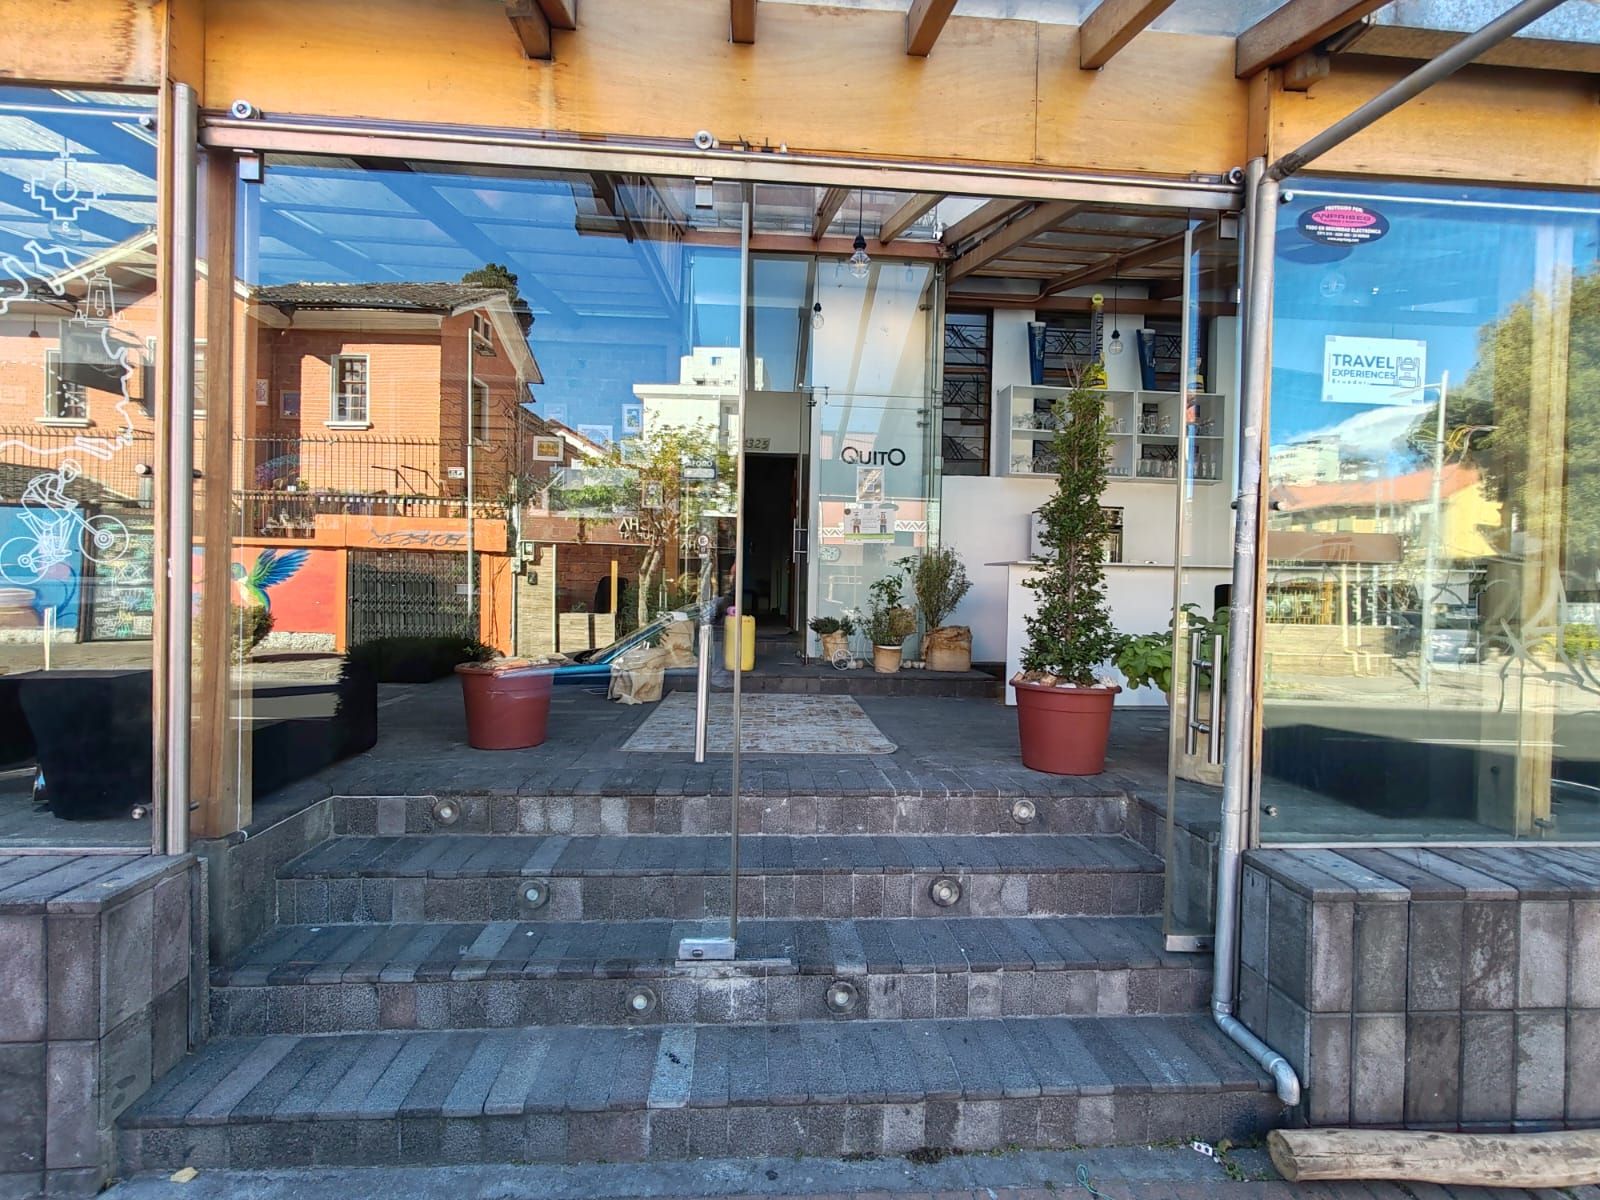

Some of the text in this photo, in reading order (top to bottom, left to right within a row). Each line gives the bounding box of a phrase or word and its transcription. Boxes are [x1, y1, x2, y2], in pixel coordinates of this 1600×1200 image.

[23, 184, 31, 193] S
[1332, 353, 1394, 369] TRAVEL
[1332, 368, 1395, 379] EXPERIENCES
[841, 446, 906, 466] QUITO
